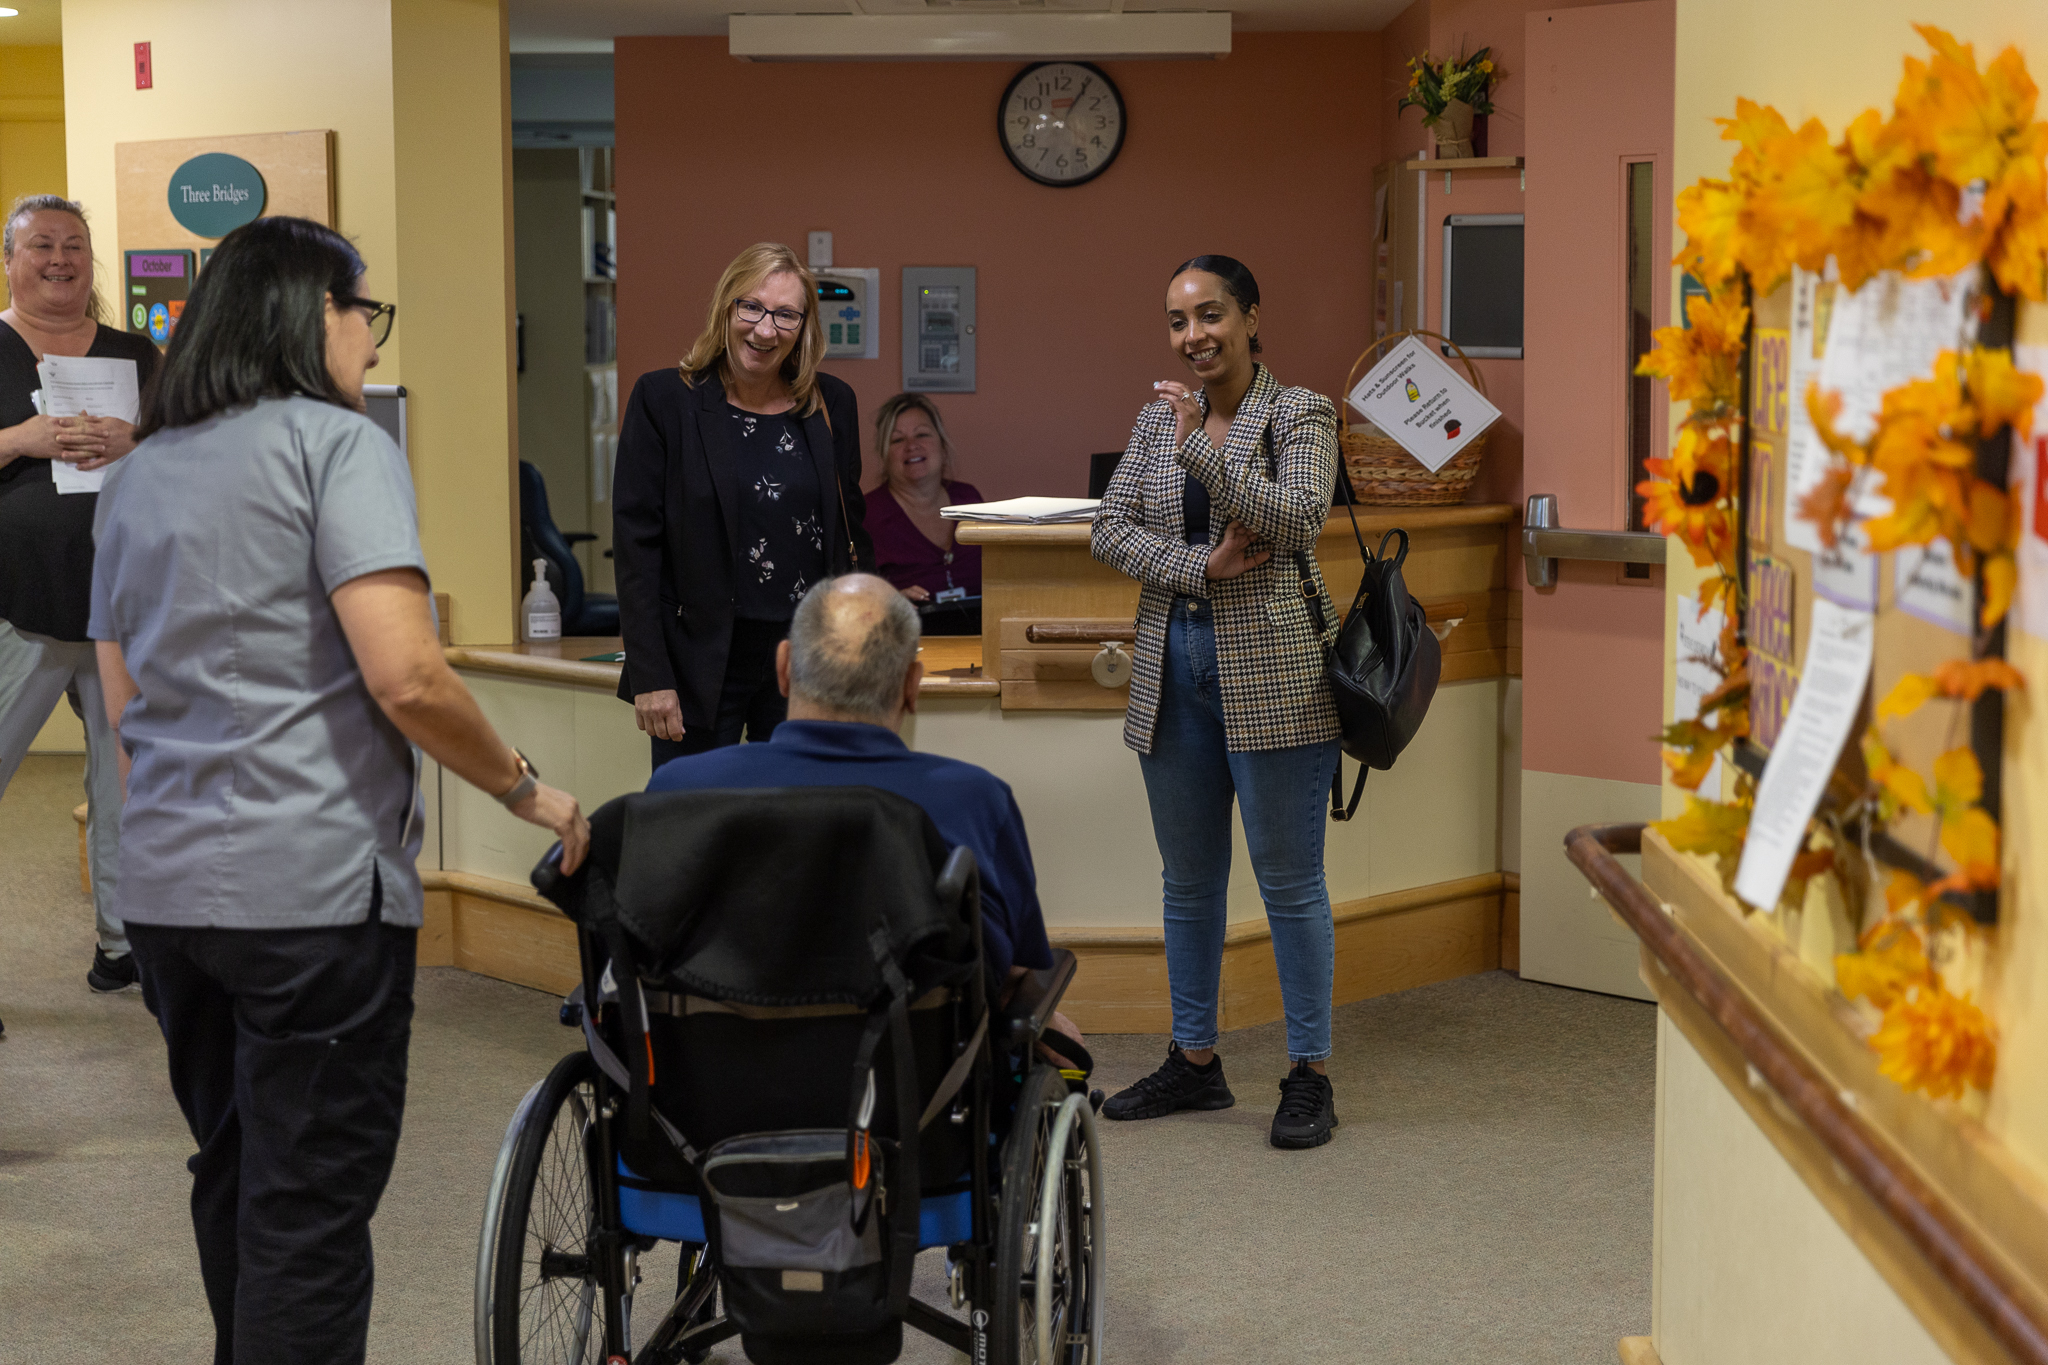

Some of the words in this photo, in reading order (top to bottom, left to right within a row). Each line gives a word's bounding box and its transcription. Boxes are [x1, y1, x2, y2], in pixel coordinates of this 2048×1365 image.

[1039, 82, 1050, 96] 11
[1054, 76, 1072, 91] 12
[1023, 96, 1042, 111] 10
[1088, 96, 1101, 111] 2
[1017, 116, 1030, 130] 9
[1095, 114, 1106, 130] 3
[1023, 134, 1036, 148] 8
[1090, 135, 1101, 148] 4
[1038, 147, 1049, 161] 7
[1056, 154, 1068, 168] 6
[1075, 147, 1087, 162] 5
[181, 185, 210, 203] Three
[213, 183, 249, 205] Bridges
[142, 259, 172, 273] October
[1361, 387, 1376, 402] Hats
[1379, 357, 1408, 385] Sunscreen
[1406, 350, 1416, 360] for
[1376, 378, 1399, 400] Outdoor
[1397, 363, 1416, 379] Walks
[1404, 408, 1424, 426] Please
[1422, 392, 1440, 410] Return
[1439, 387, 1448, 396] to
[1416, 409, 1436, 428] Bucket
[1435, 397, 1451, 412] when
[1428, 408, 1452, 429] finished
